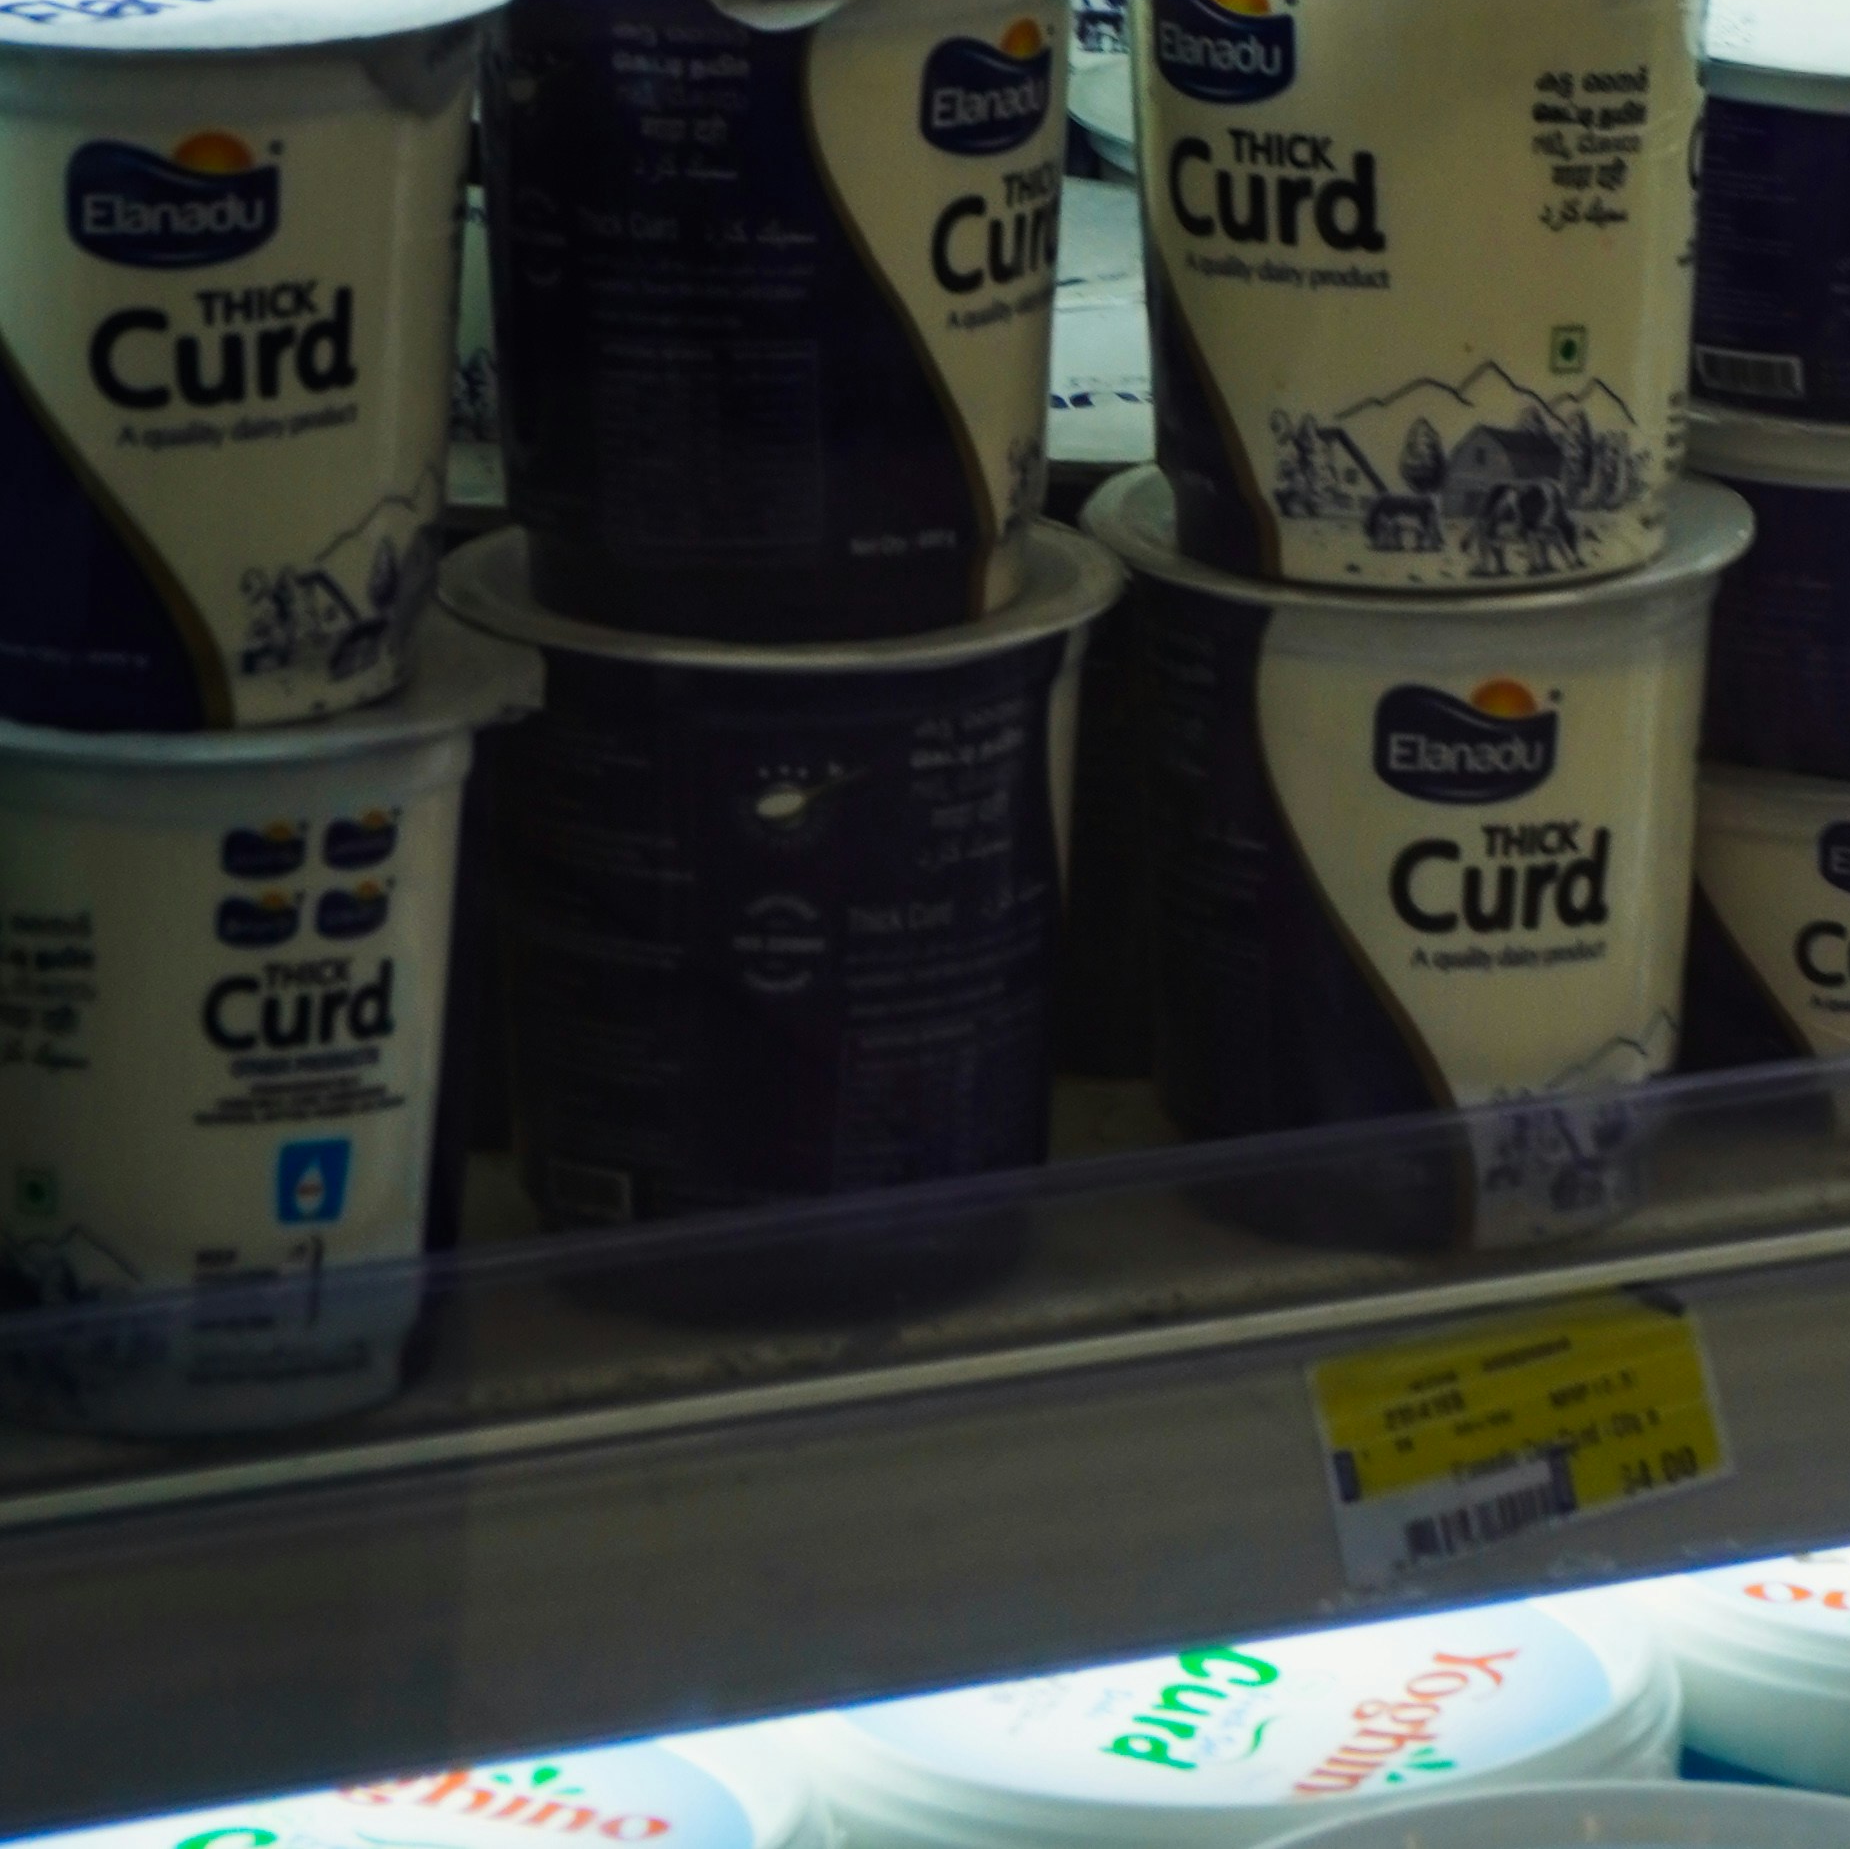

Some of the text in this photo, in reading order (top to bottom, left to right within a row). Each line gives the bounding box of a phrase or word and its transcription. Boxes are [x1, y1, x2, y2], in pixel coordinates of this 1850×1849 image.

[1157, 19, 1282, 77] Elanadu
[1228, 128, 1334, 173] THICK
[81, 192, 266, 236] Elanadu
[1167, 137, 1387, 254] Curd
[1308, 264, 1392, 291] product
[195, 280, 319, 327] THICK
[88, 286, 358, 411] Curd
[1387, 733, 1544, 774] Elanadu
[1480, 820, 1582, 859] THICK
[1388, 827, 1612, 935] Curd
[263, 956, 354, 991] THICK
[202, 957, 396, 1054] Curd
[1100, 1645, 1284, 1773] Curd
